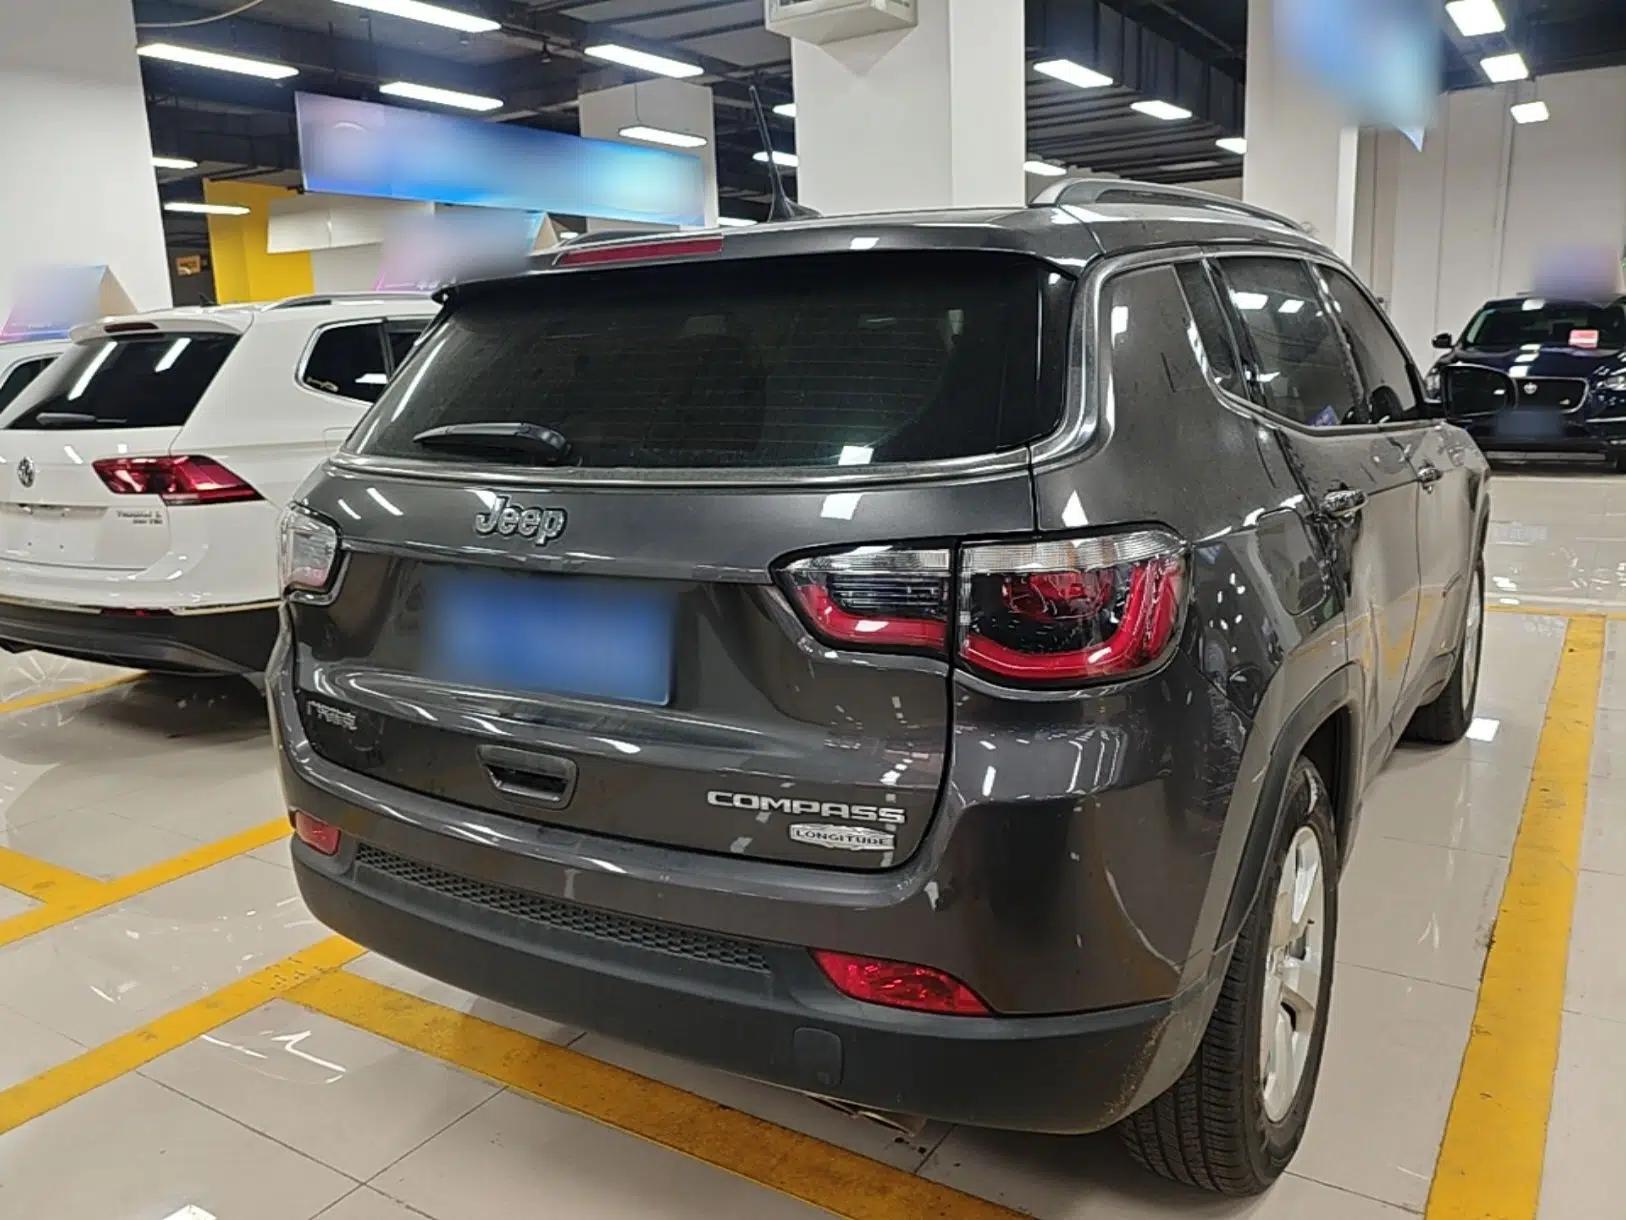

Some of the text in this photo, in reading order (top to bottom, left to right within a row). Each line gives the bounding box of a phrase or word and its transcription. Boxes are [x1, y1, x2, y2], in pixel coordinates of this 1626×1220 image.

[475, 495, 566, 545] Jeep
[707, 790, 905, 823] COMPASS
[795, 829, 888, 846] LONGITUDE
